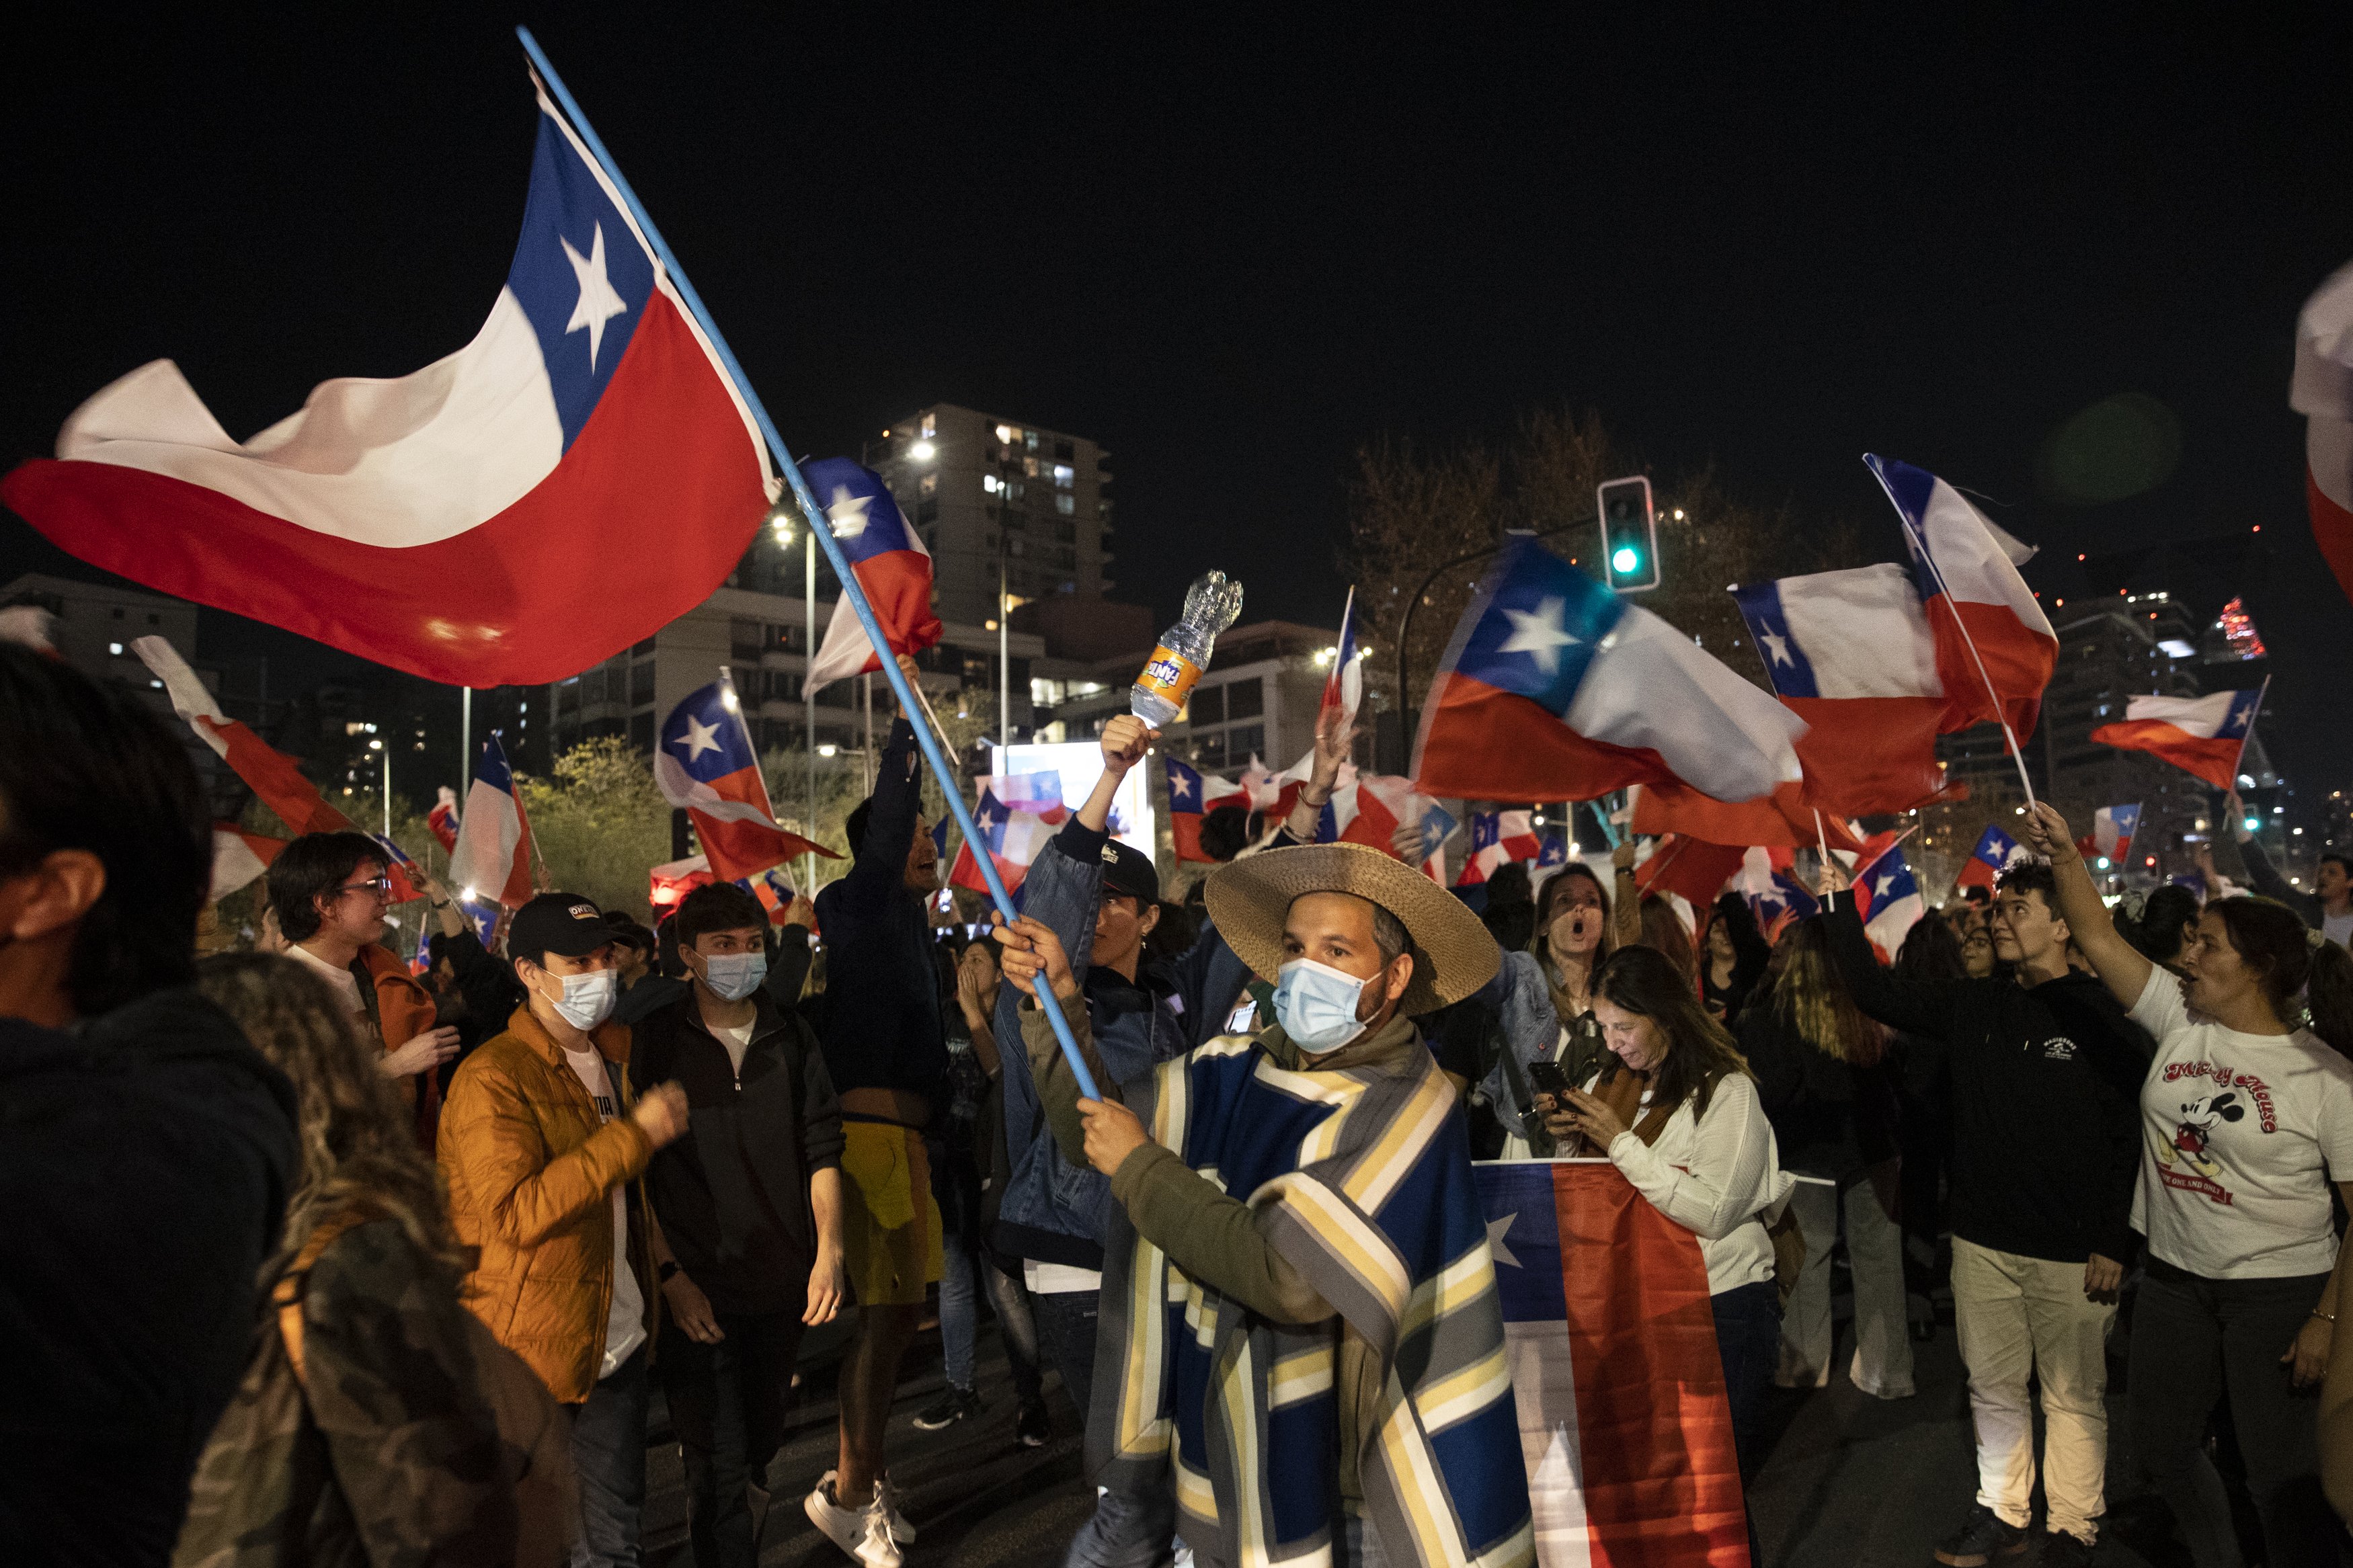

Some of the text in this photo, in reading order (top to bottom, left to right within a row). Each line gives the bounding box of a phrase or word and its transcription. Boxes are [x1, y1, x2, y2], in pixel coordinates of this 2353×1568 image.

[2163, 1061, 2278, 1134] Micey Mouse
[2172, 1178, 2187, 1187] ONE
[2188, 1180, 2203, 1189] AND
[2203, 1183, 2221, 1194] ONLY
